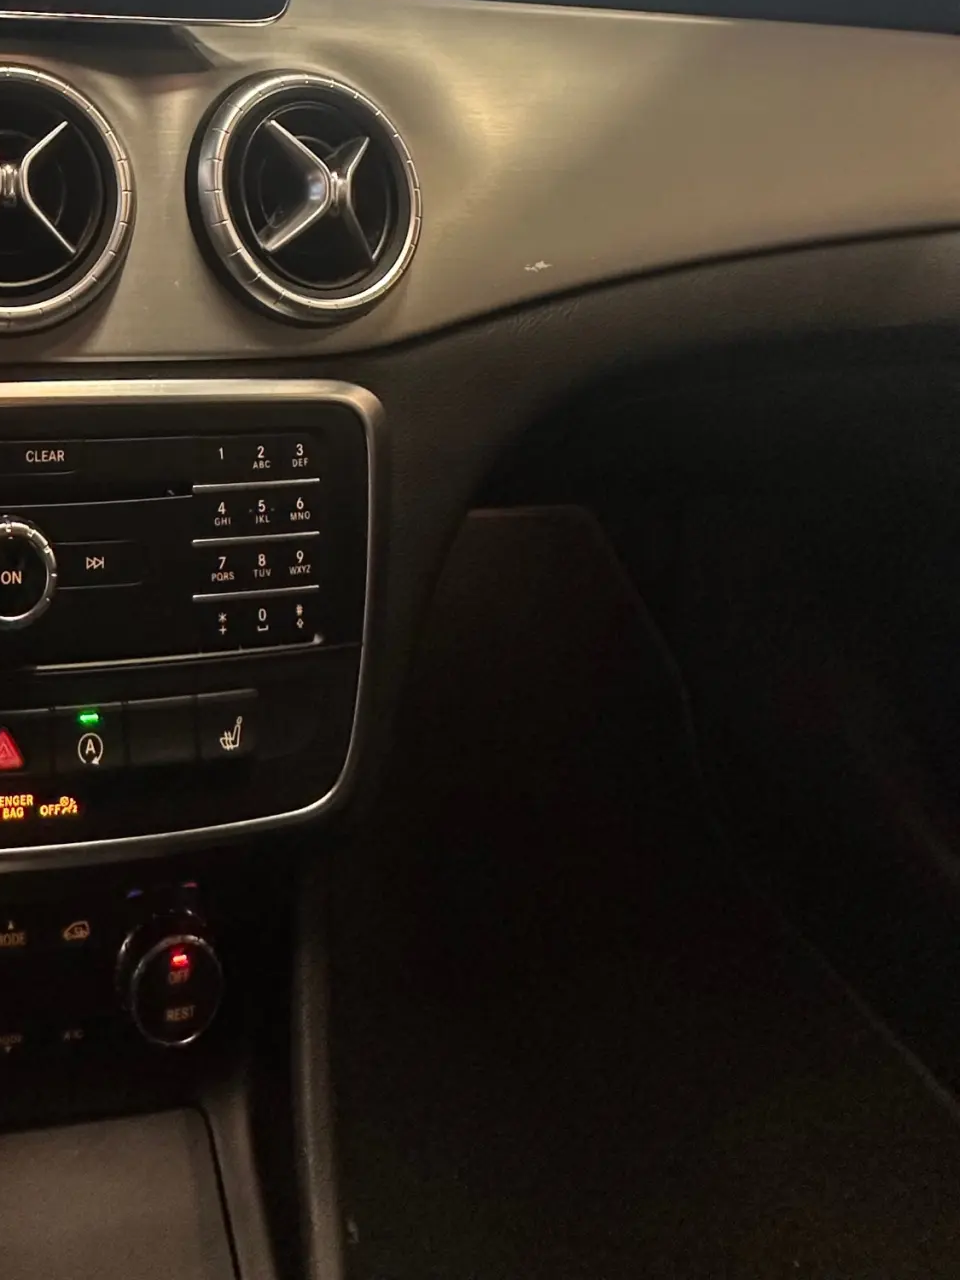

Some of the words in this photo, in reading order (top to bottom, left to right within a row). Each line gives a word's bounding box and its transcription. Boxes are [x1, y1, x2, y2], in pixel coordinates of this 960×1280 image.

[218, 447, 224, 460] 1
[257, 446, 265, 458] 2
[296, 443, 304, 456] 3
[26, 450, 65, 462] CLEAR
[252, 460, 271, 469] ABC
[292, 458, 308, 467] DEF
[218, 502, 226, 514] 4
[258, 500, 266, 512] 5
[296, 497, 304, 509] 6
[258, 554, 266, 566] 8
[296, 551, 304, 563] 9
[218, 557, 226, 570] 7
[0, 571, 22, 585] ON
[85, 739, 96, 755] A
[3, 807, 24, 819] BAG
[40, 804, 61, 817] OFF
